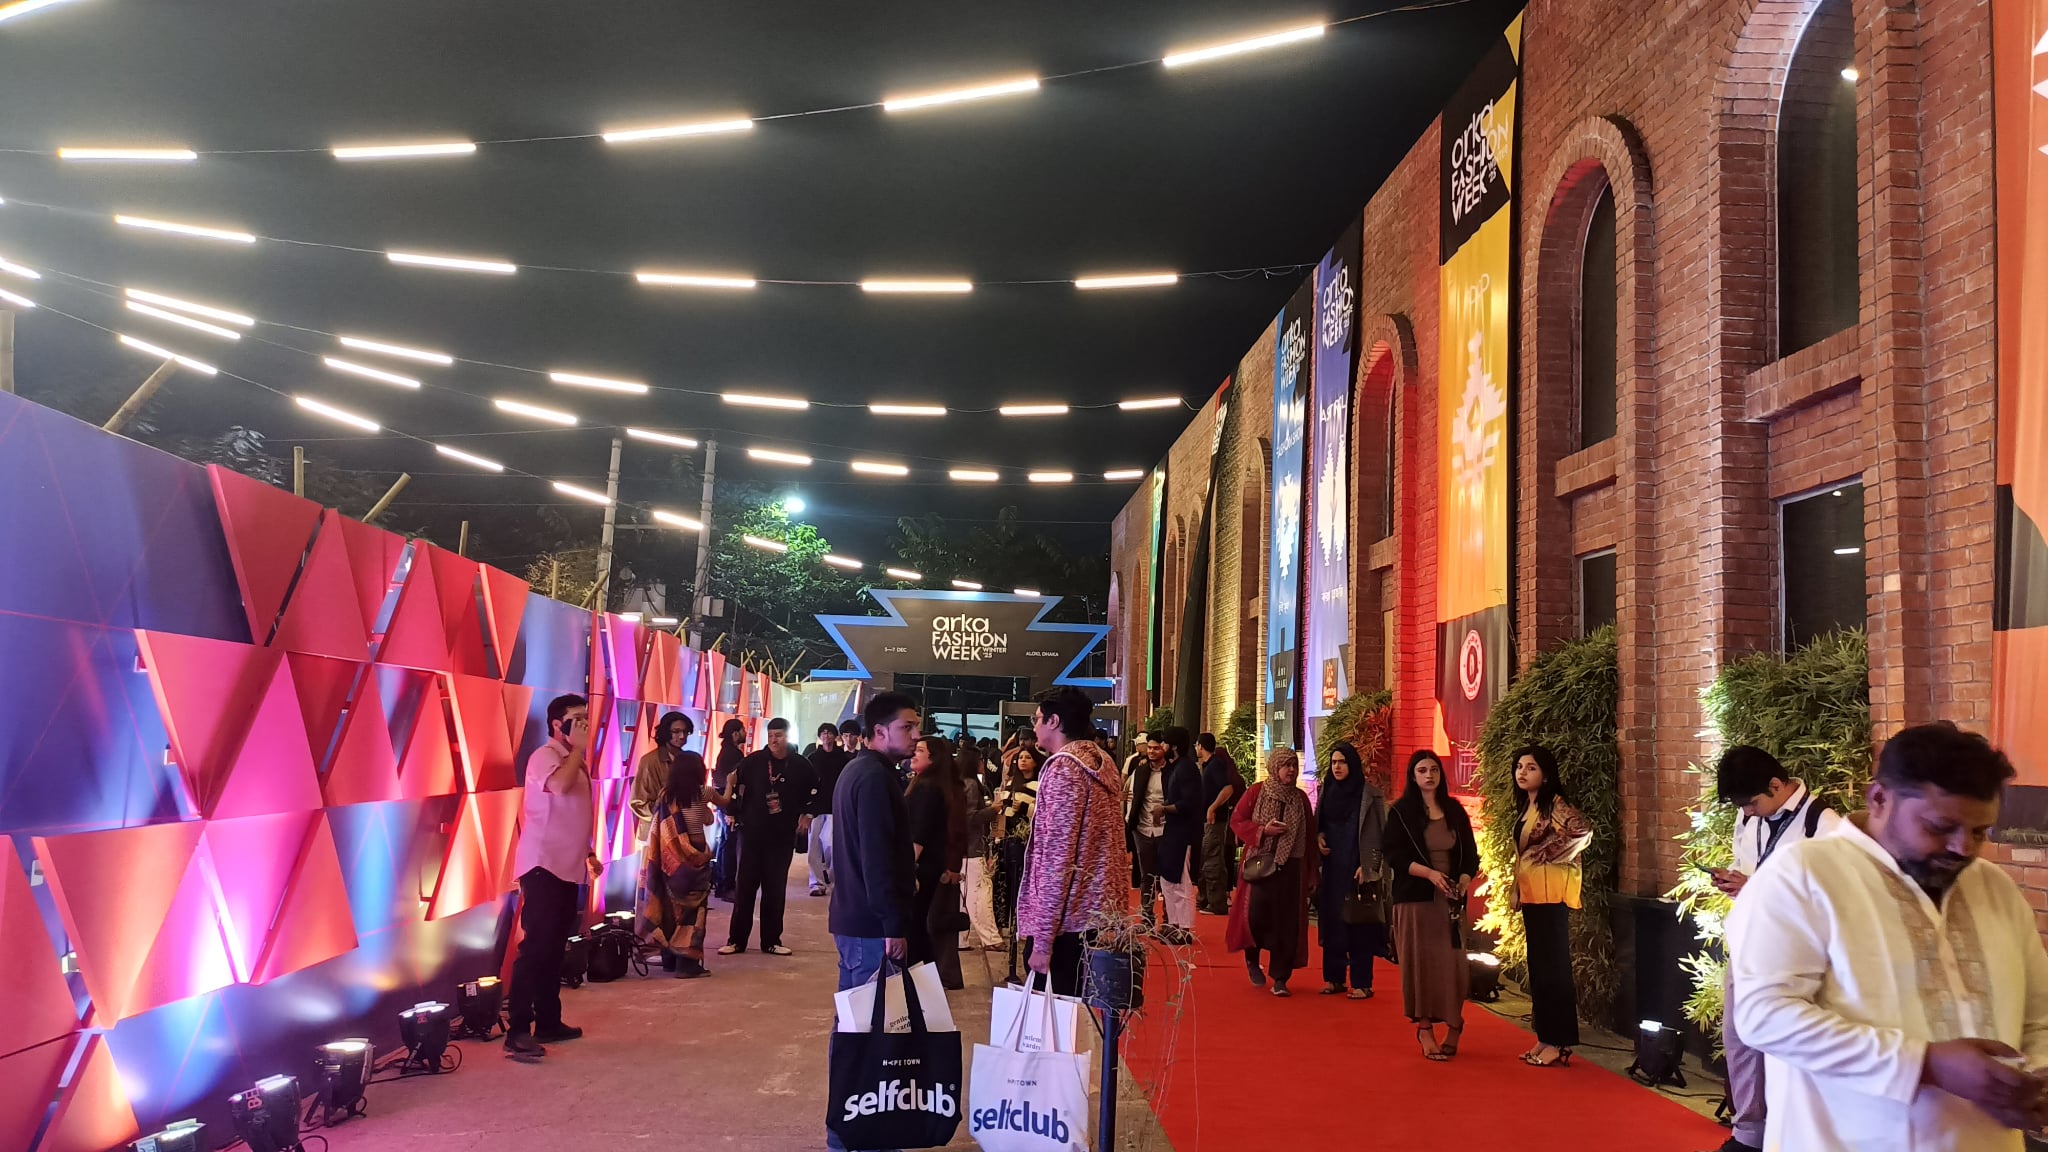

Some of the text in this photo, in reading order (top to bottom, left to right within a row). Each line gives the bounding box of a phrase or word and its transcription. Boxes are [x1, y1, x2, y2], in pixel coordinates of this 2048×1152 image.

[1451, 98, 1494, 169] arka
[1451, 112, 1509, 201] FASHION
[1452, 165, 1488, 226] WEEK
[1323, 264, 1348, 310] arka
[932, 613, 990, 633] arka
[932, 631, 1008, 648] FASHION
[932, 645, 982, 661] WEEK
[843, 1078, 956, 1122] selfclub
[973, 1098, 1070, 1144] selfclub
